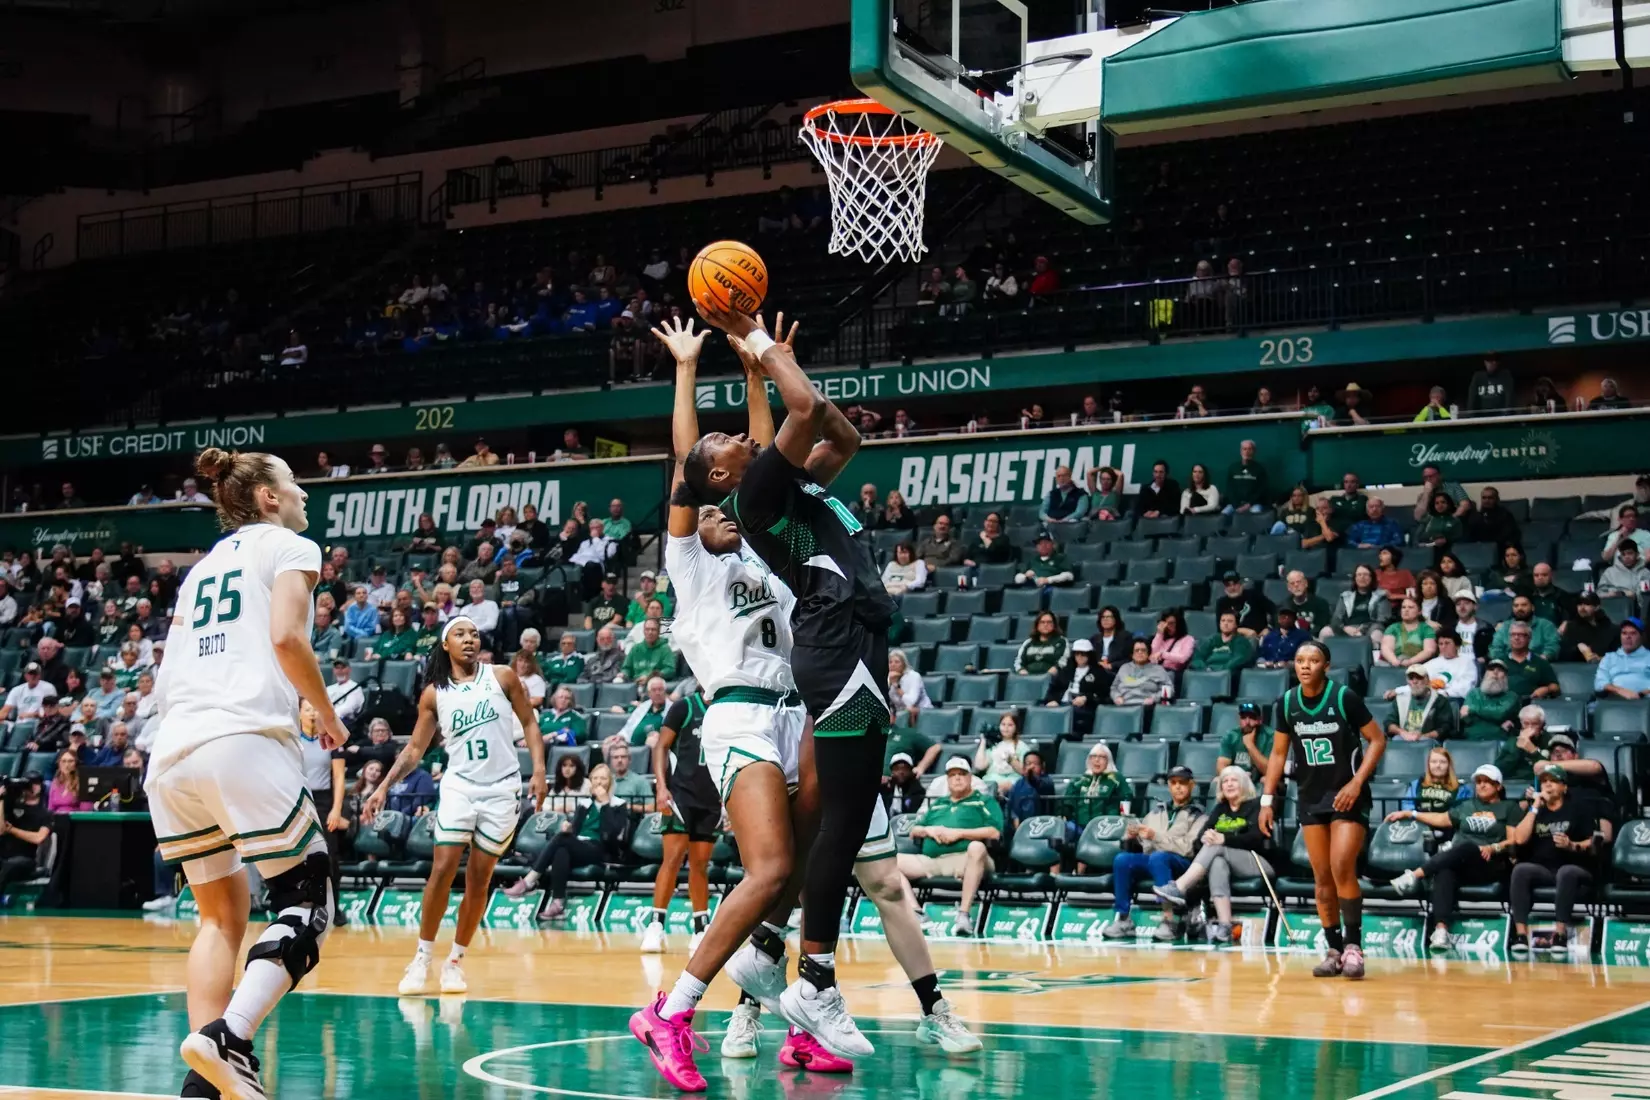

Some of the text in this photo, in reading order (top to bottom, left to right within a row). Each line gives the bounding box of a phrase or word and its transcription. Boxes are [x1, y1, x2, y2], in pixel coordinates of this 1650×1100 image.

[1259, 337, 1314, 366] 203
[724, 366, 990, 406] UF EDIT UNION
[415, 406, 454, 430] 202
[64, 425, 265, 458] USF CREDIT UNION
[1408, 441, 1547, 467] Yuengling CENTER
[326, 487, 427, 538] SOUTH
[192, 567, 244, 631] 55
[728, 576, 777, 611] Bull
[198, 632, 226, 657] BRITO
[761, 618, 777, 649] 8
[451, 699, 499, 734] Bulls
[465, 739, 489, 760] 13
[1301, 738, 1336, 766] 12
[993, 921, 1015, 931] SEAT
[1062, 922, 1085, 933] SEAT
[1365, 932, 1389, 943] SEAT
[1614, 940, 1640, 951] SEAT
